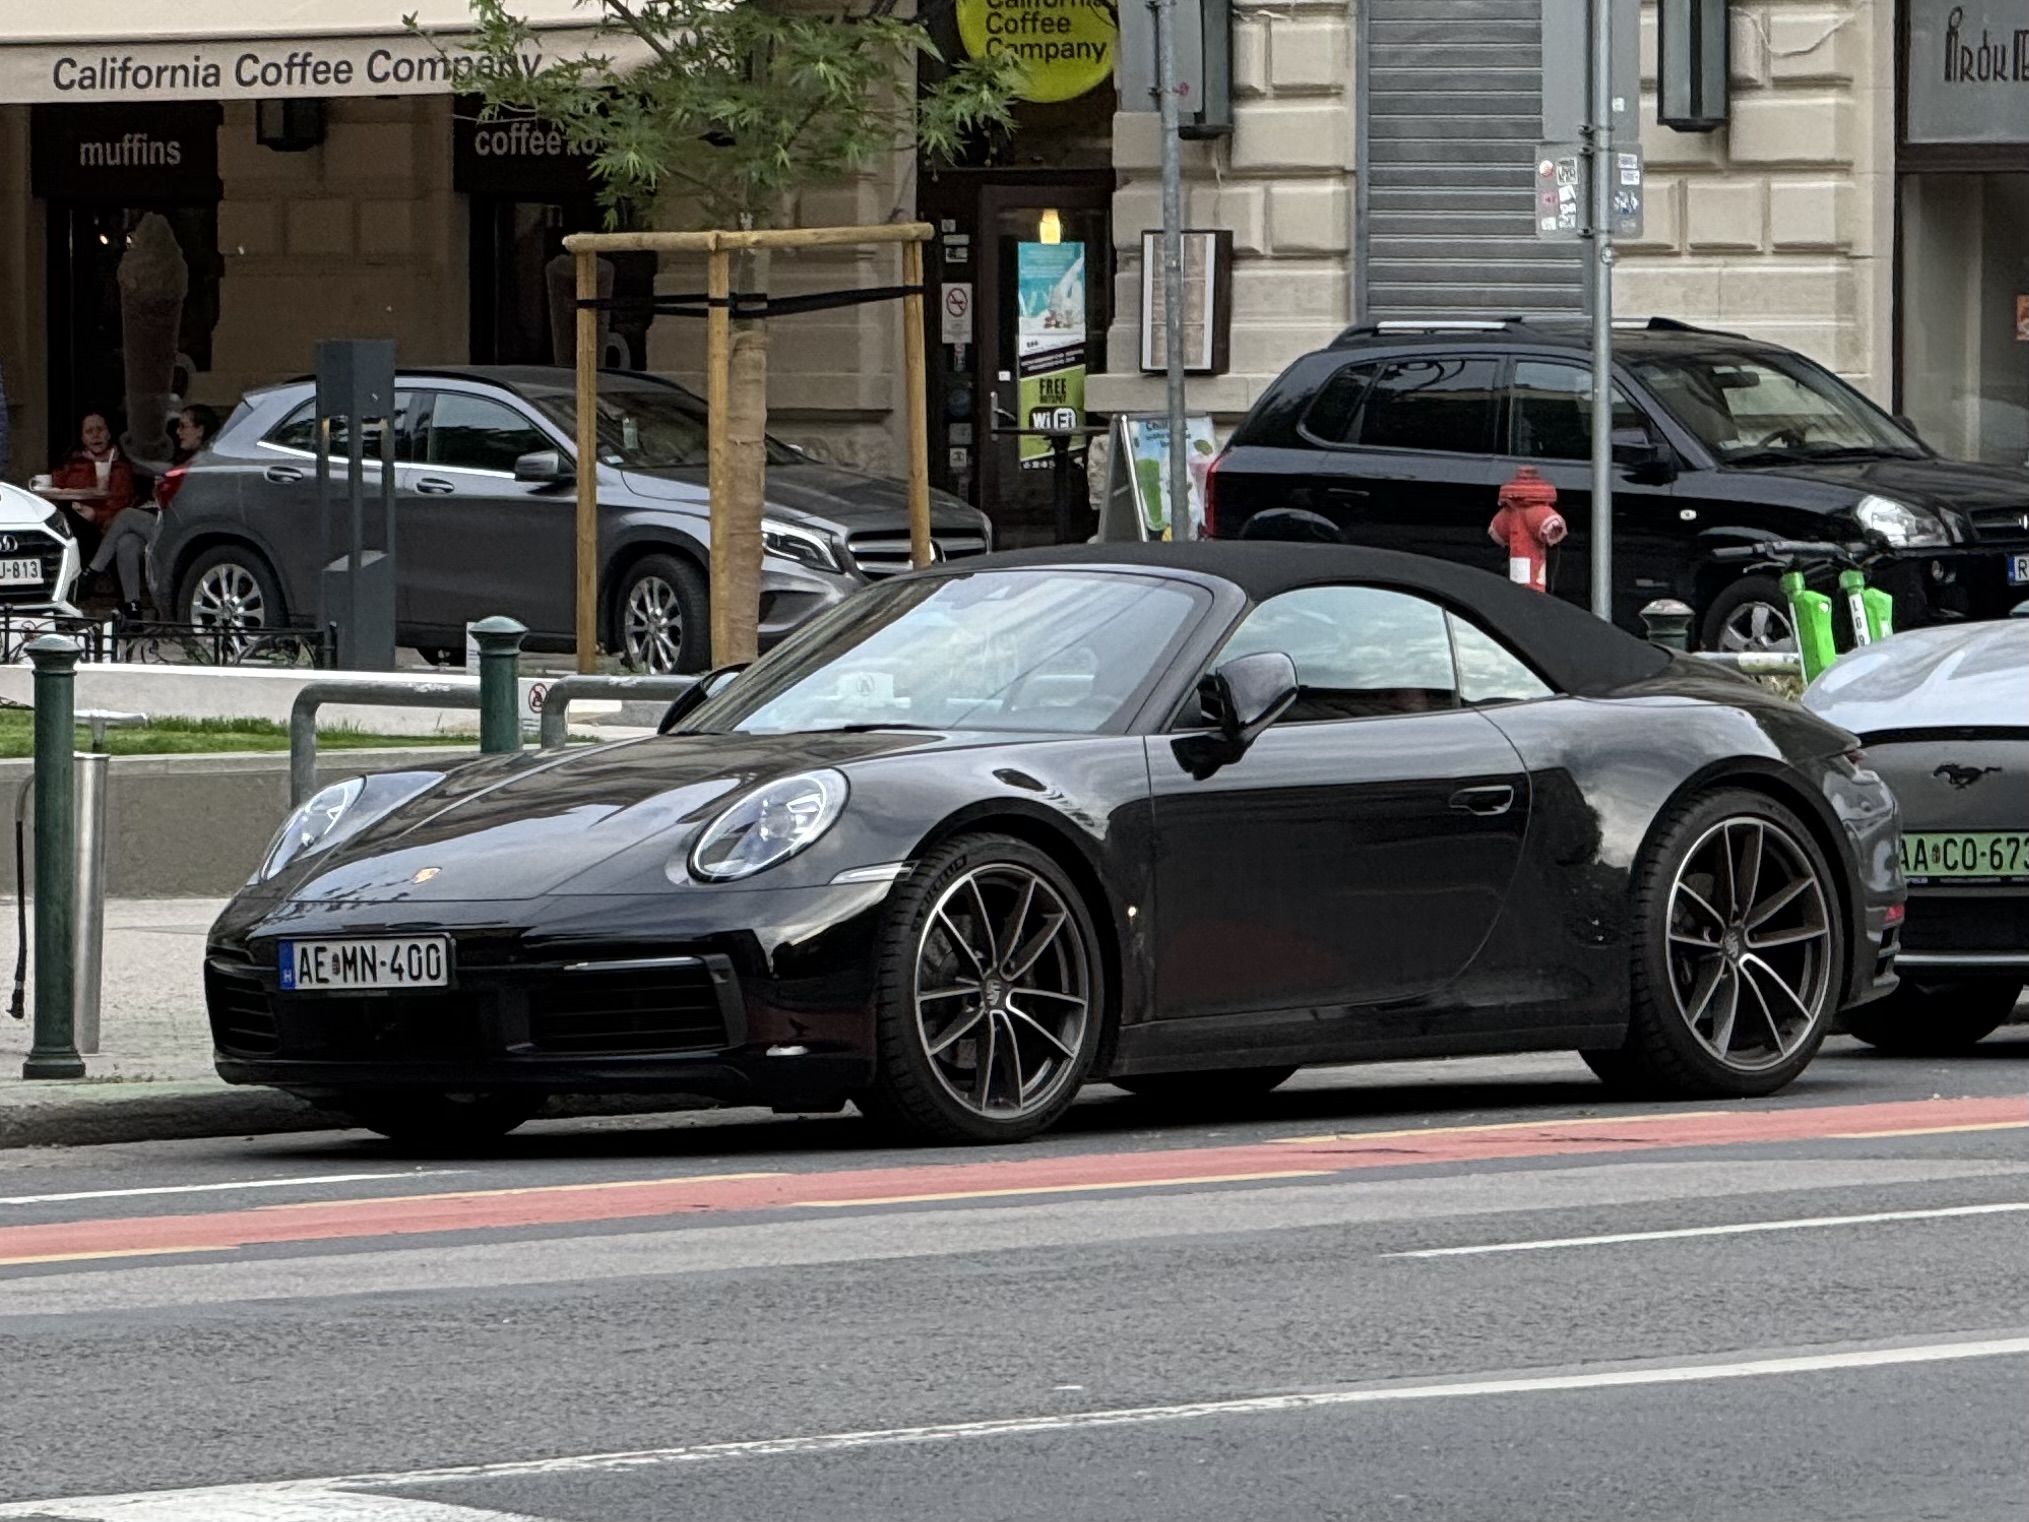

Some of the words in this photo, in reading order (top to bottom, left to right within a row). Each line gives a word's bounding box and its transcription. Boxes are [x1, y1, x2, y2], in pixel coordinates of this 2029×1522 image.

[985, 12, 1071, 34] Coffee
[53, 57, 221, 90] California
[235, 51, 354, 87] Coffee
[80, 133, 181, 166] muffins
[475, 123, 562, 156] coffee
[1040, 378, 1066, 395] FREE
[283, 971, 293, 983] H
